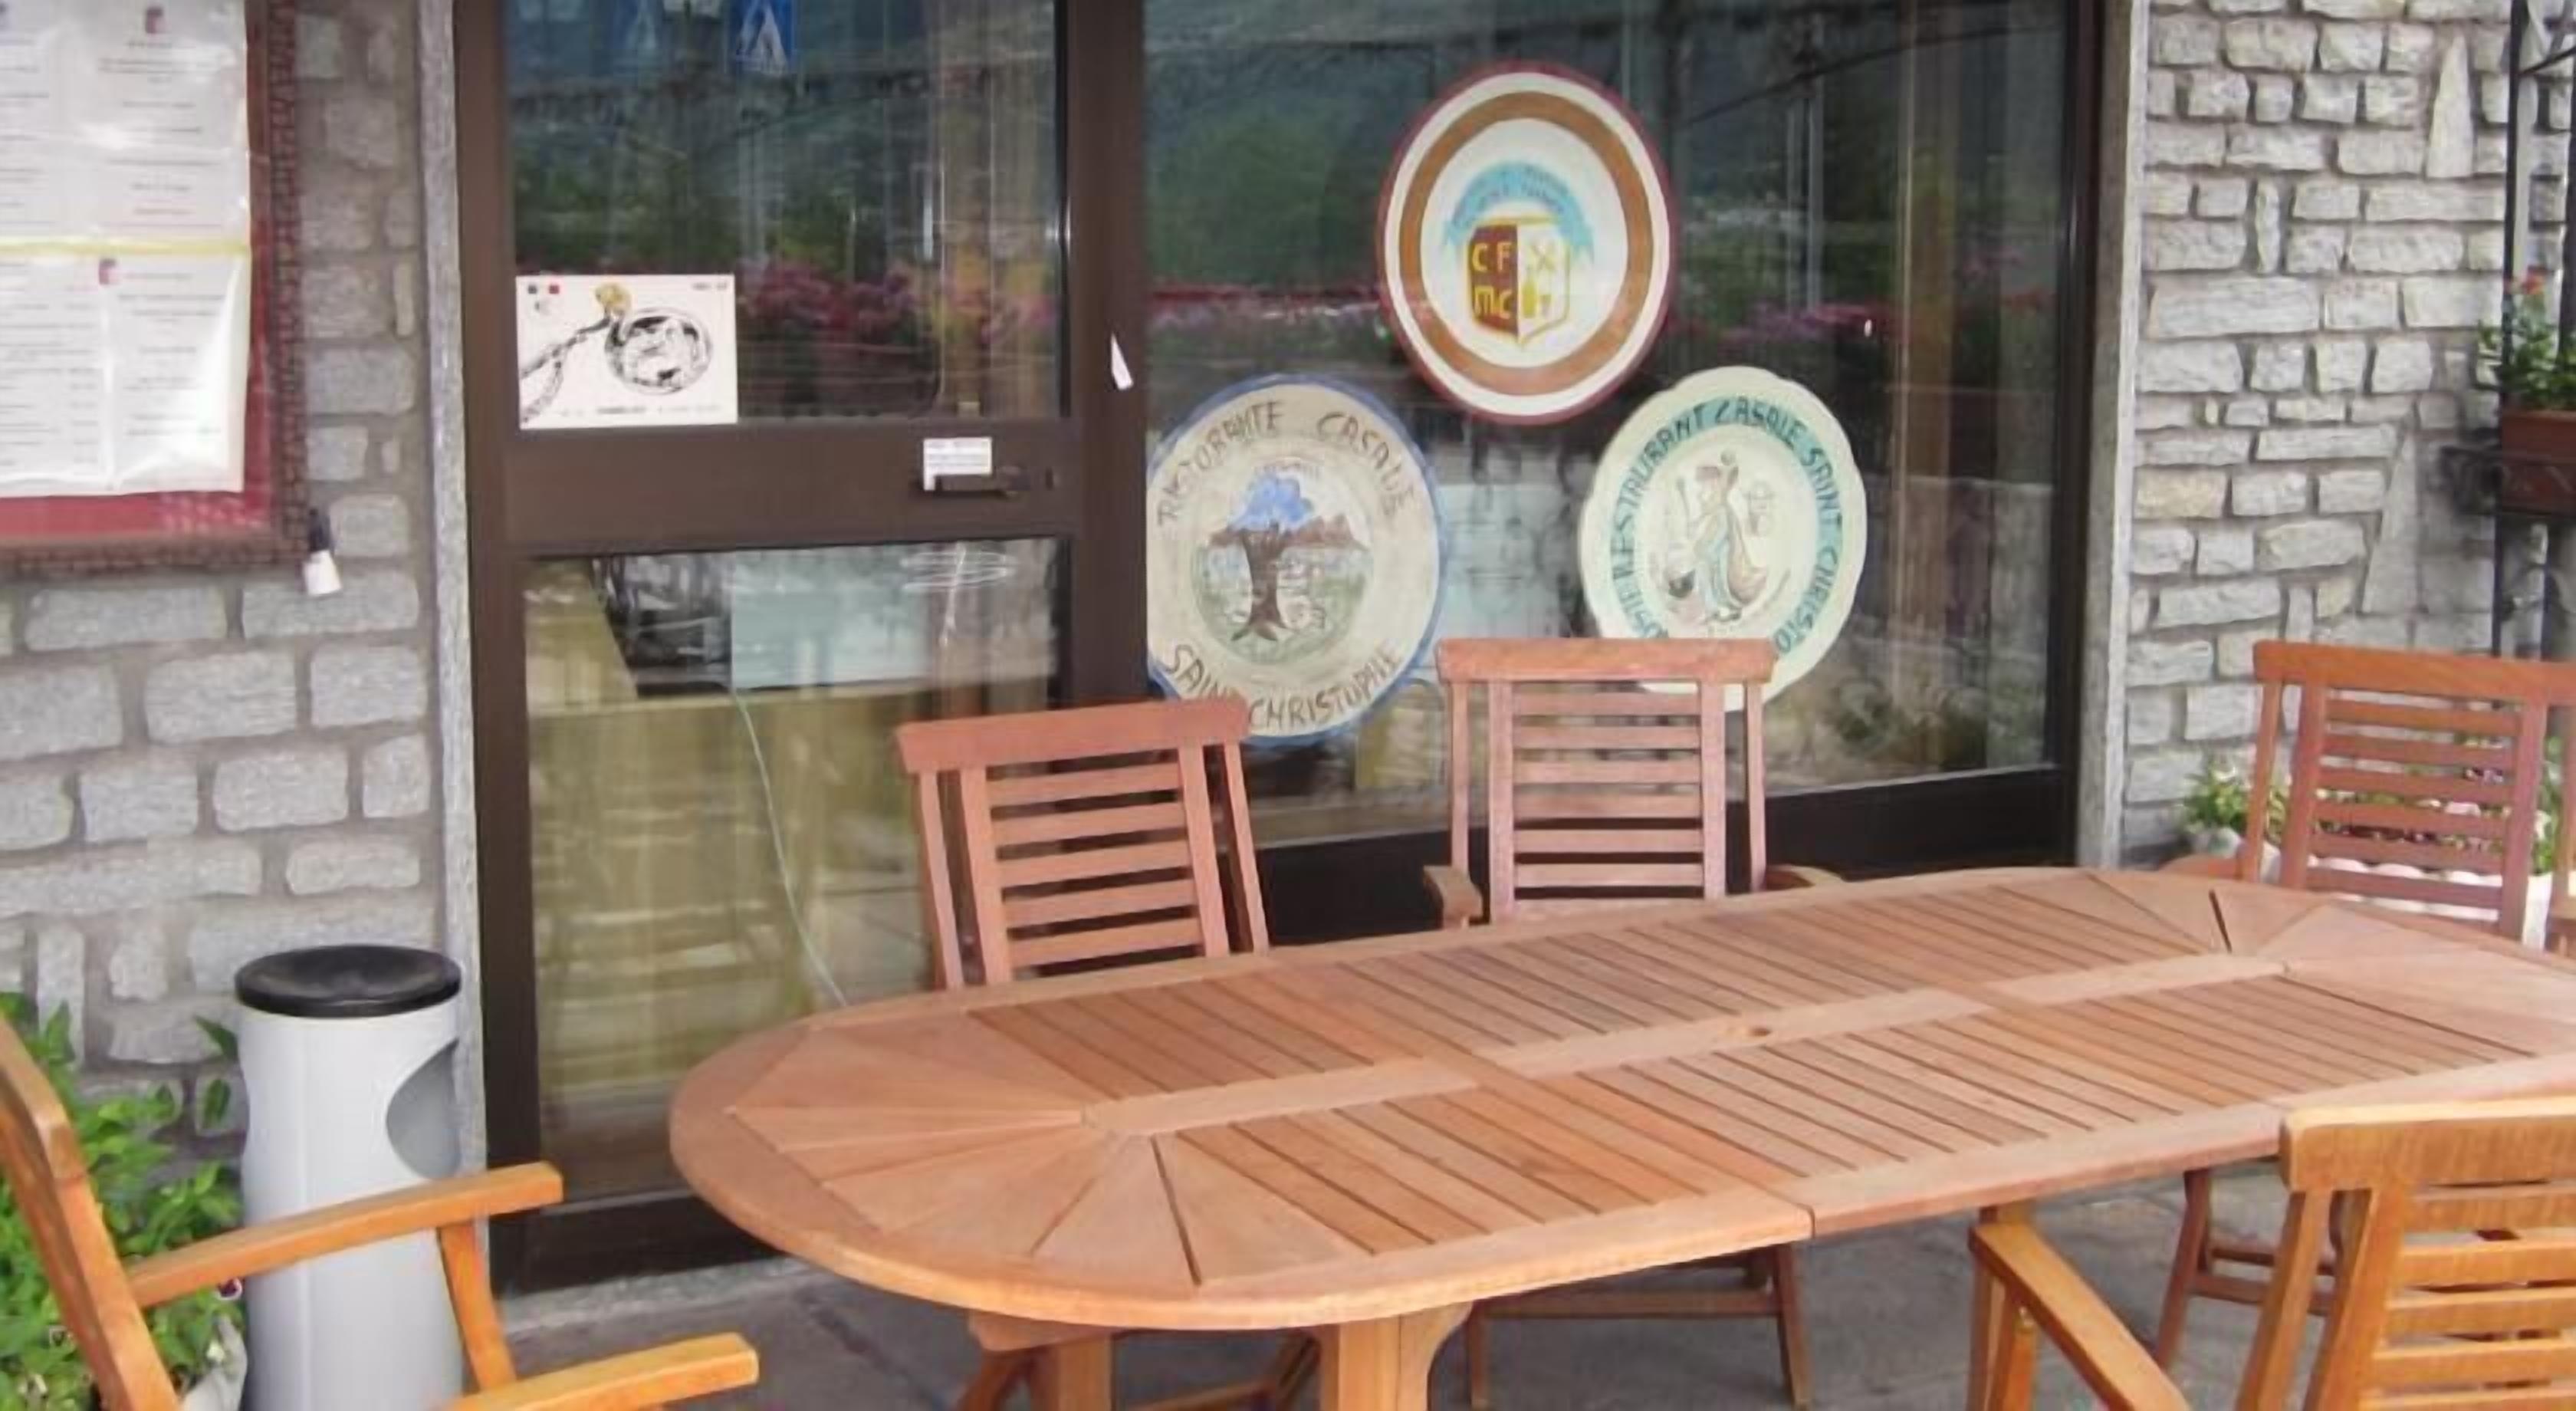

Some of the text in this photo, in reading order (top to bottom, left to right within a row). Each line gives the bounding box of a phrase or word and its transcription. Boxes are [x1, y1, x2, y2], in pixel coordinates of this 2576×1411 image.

[1317, 411, 1415, 518] CASALE
[1714, 396, 1807, 451] CASALE
[1611, 403, 1707, 581] RESTAURANT
[1802, 446, 1843, 534] SAINT
[1773, 545, 1838, 653] CHRISTO
[1162, 644, 1405, 731] SAIN CHRISTOPHE
